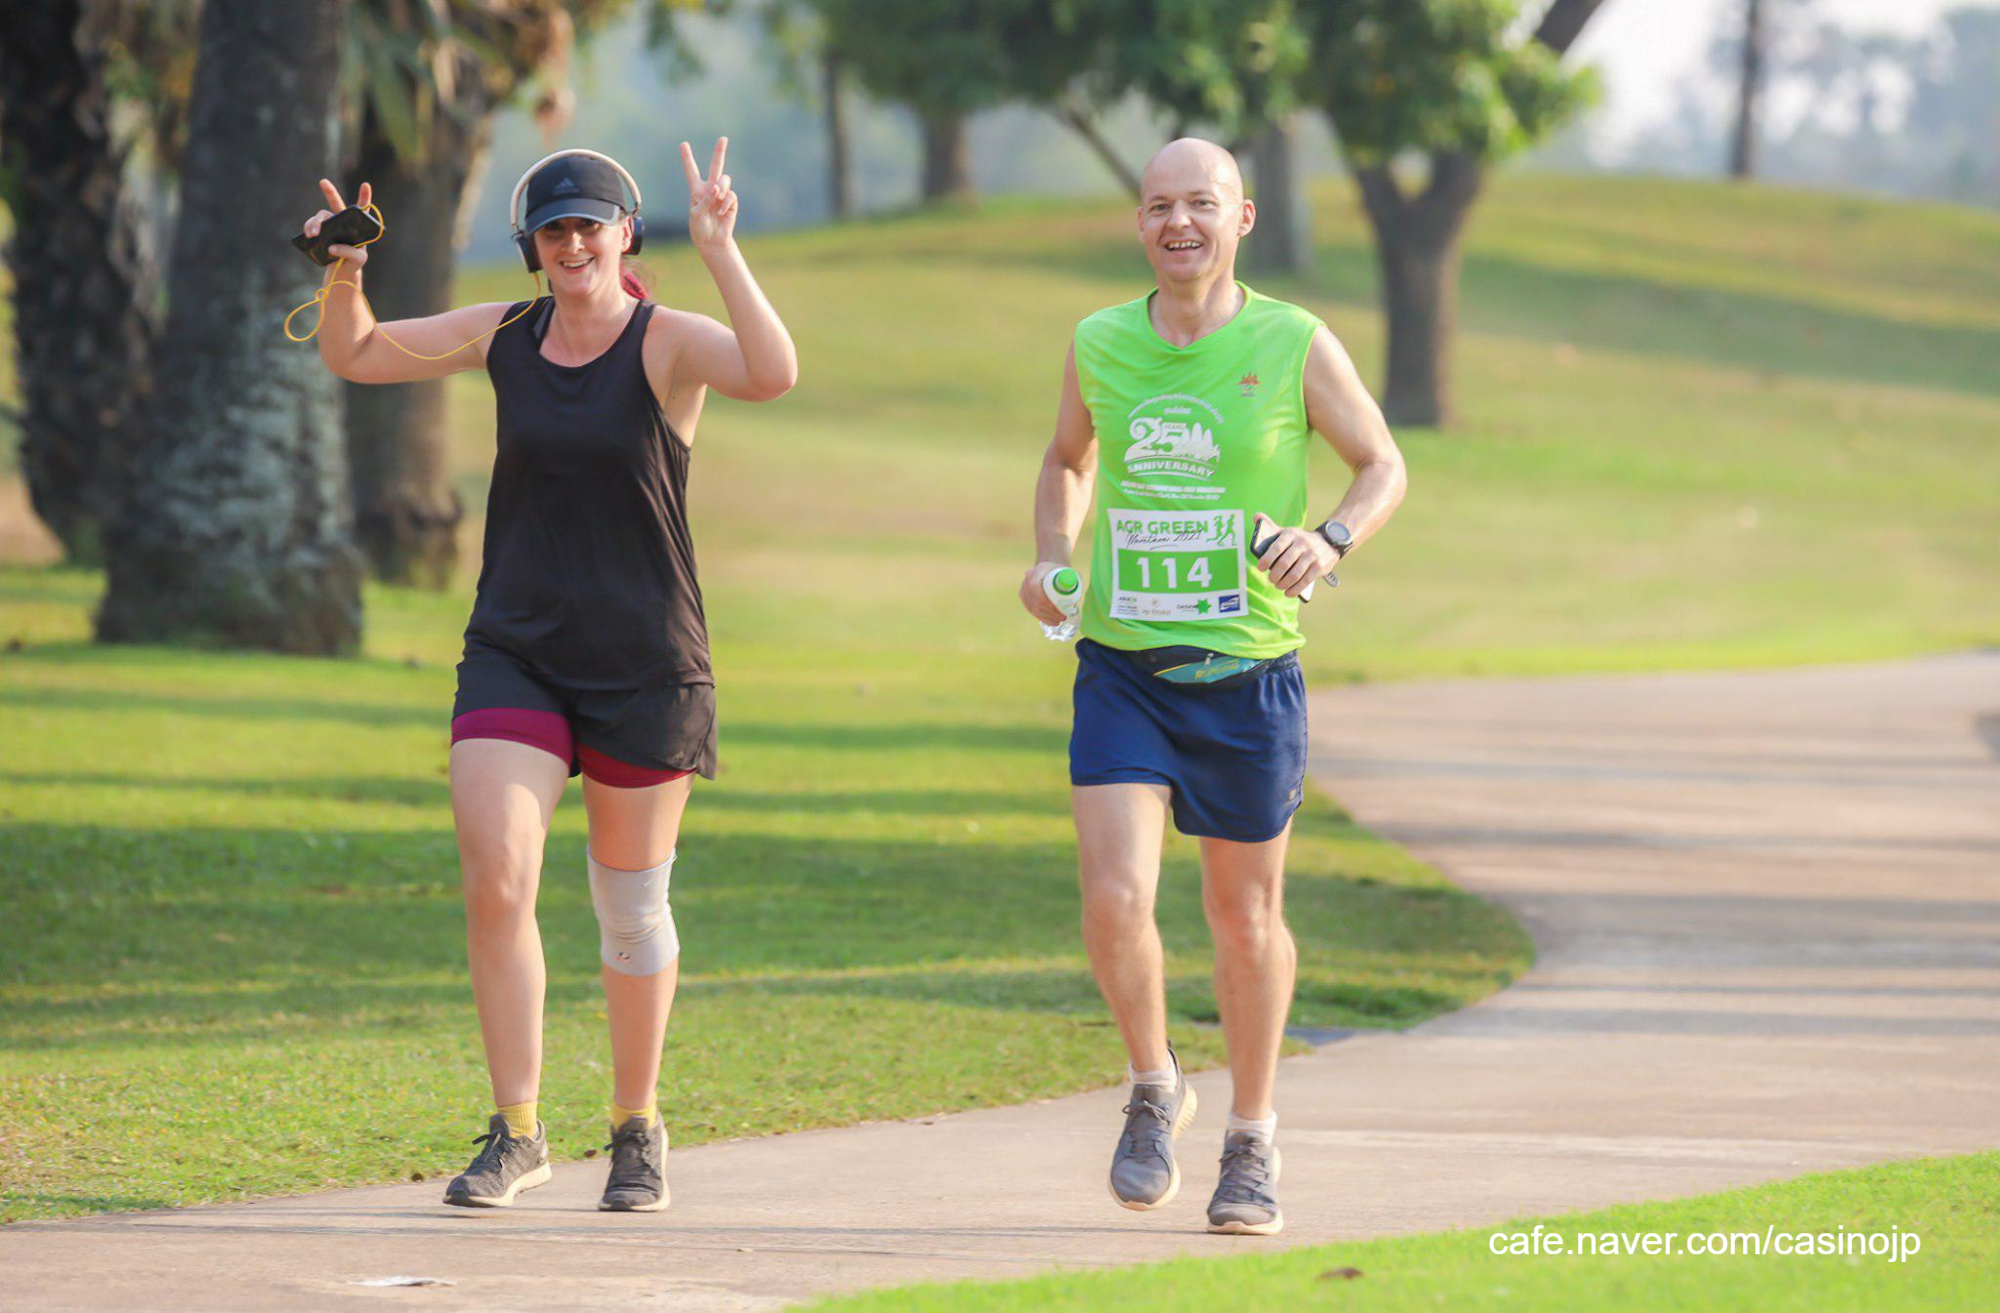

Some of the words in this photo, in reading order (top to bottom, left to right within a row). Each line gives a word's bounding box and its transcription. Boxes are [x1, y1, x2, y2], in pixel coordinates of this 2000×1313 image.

[1127, 460, 1214, 478] ANNIVERSARY
[1147, 520, 1208, 534] GREEN
[1136, 557, 1212, 589] 114
